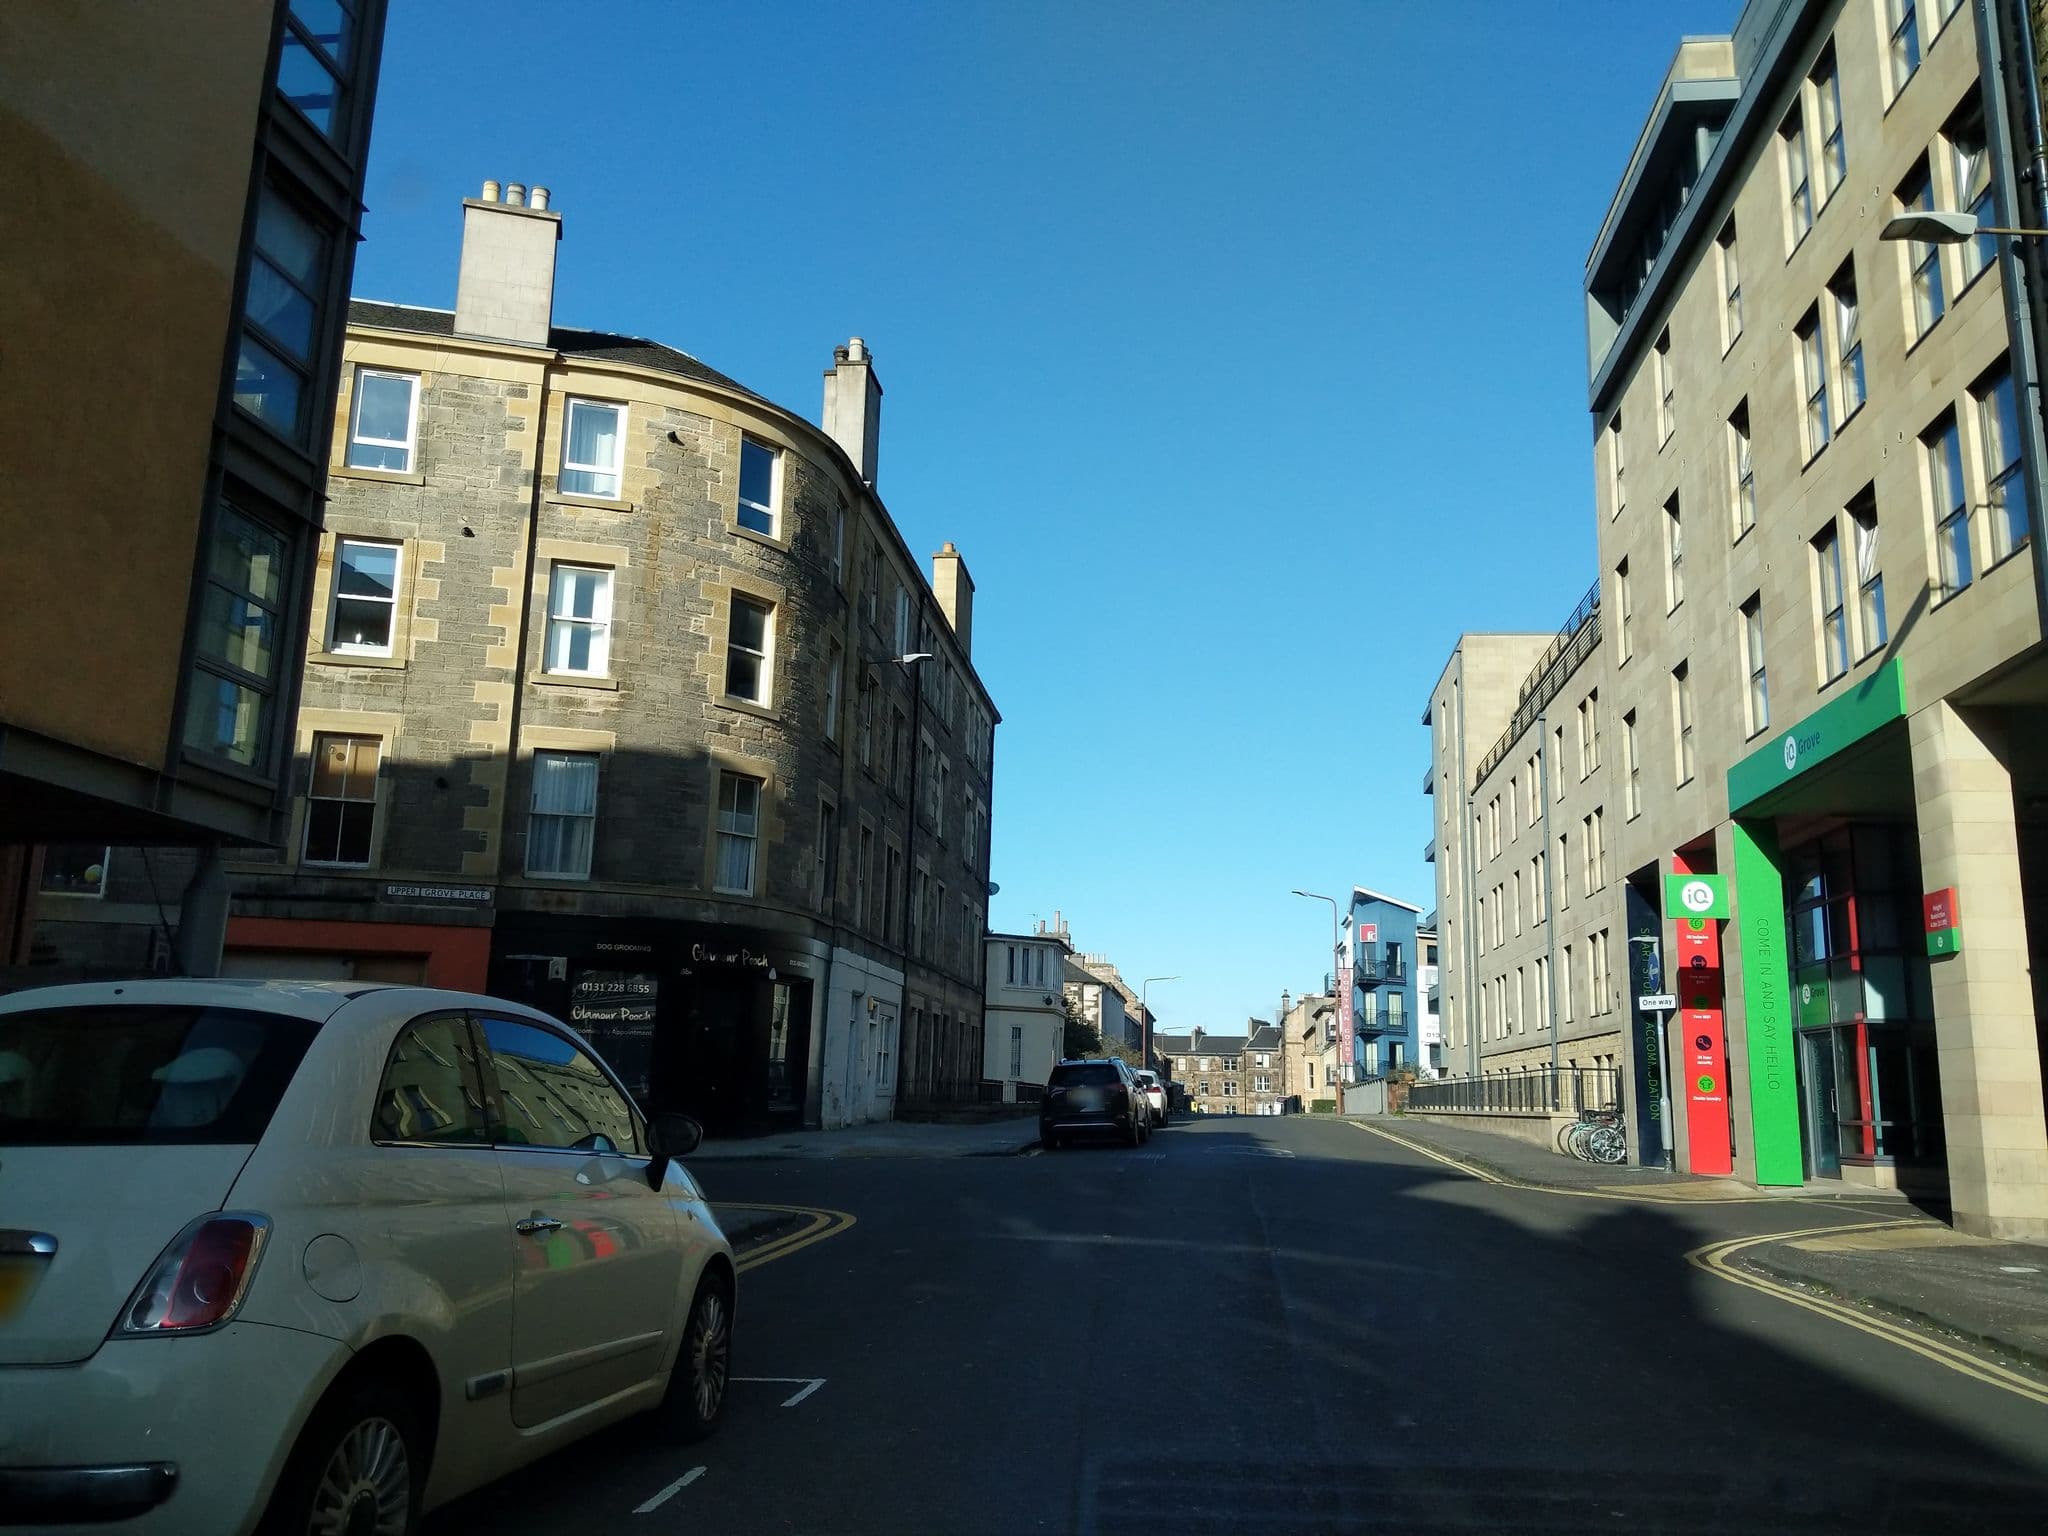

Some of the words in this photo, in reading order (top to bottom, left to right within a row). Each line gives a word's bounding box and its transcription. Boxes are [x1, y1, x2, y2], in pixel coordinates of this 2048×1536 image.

[1798, 731, 1821, 755] Grove
[391, 886, 416, 896] UPPER
[424, 888, 457, 898] GROVE
[458, 890, 487, 899] PLACE
[1687, 888, 1709, 904] iQ
[1756, 918, 1770, 957] COME
[596, 942, 613, 951] DOG
[742, 948, 769, 968] Pooch
[1759, 962, 1772, 976] IN
[581, 982, 605, 992] 0131
[607, 982, 625, 993] 228
[626, 983, 650, 994] 6855
[1761, 981, 1774, 1010] AND
[1642, 999, 1657, 1007] One
[572, 1005, 618, 1020] Glamour
[620, 1006, 652, 1022] Pooch
[1763, 1016, 1776, 1040] SAY
[1766, 1046, 1780, 1090] HELLO
